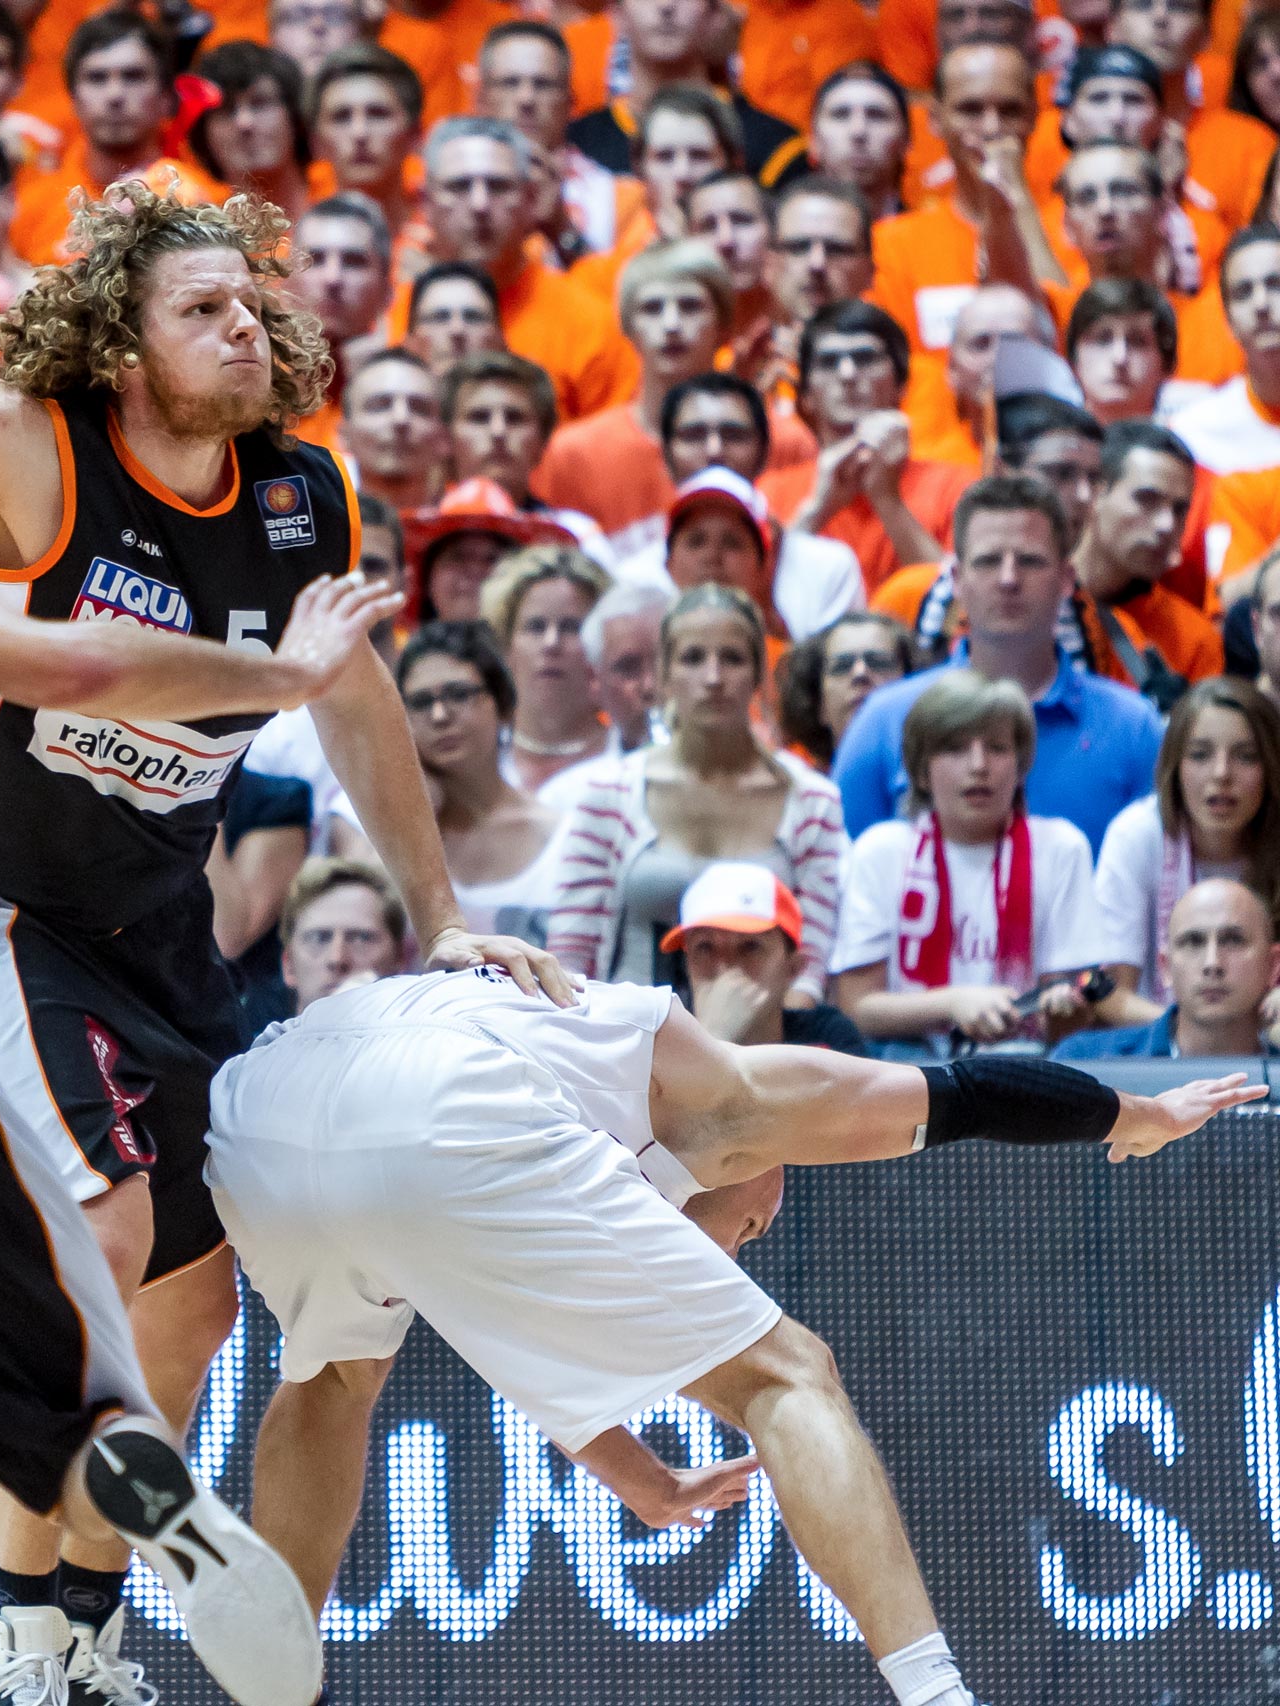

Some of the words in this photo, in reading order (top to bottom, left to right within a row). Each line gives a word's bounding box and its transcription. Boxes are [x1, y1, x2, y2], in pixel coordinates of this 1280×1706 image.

[264, 514, 309, 529] BEKO
[268, 526, 312, 541] BBL
[87, 563, 187, 629] LIQUI
